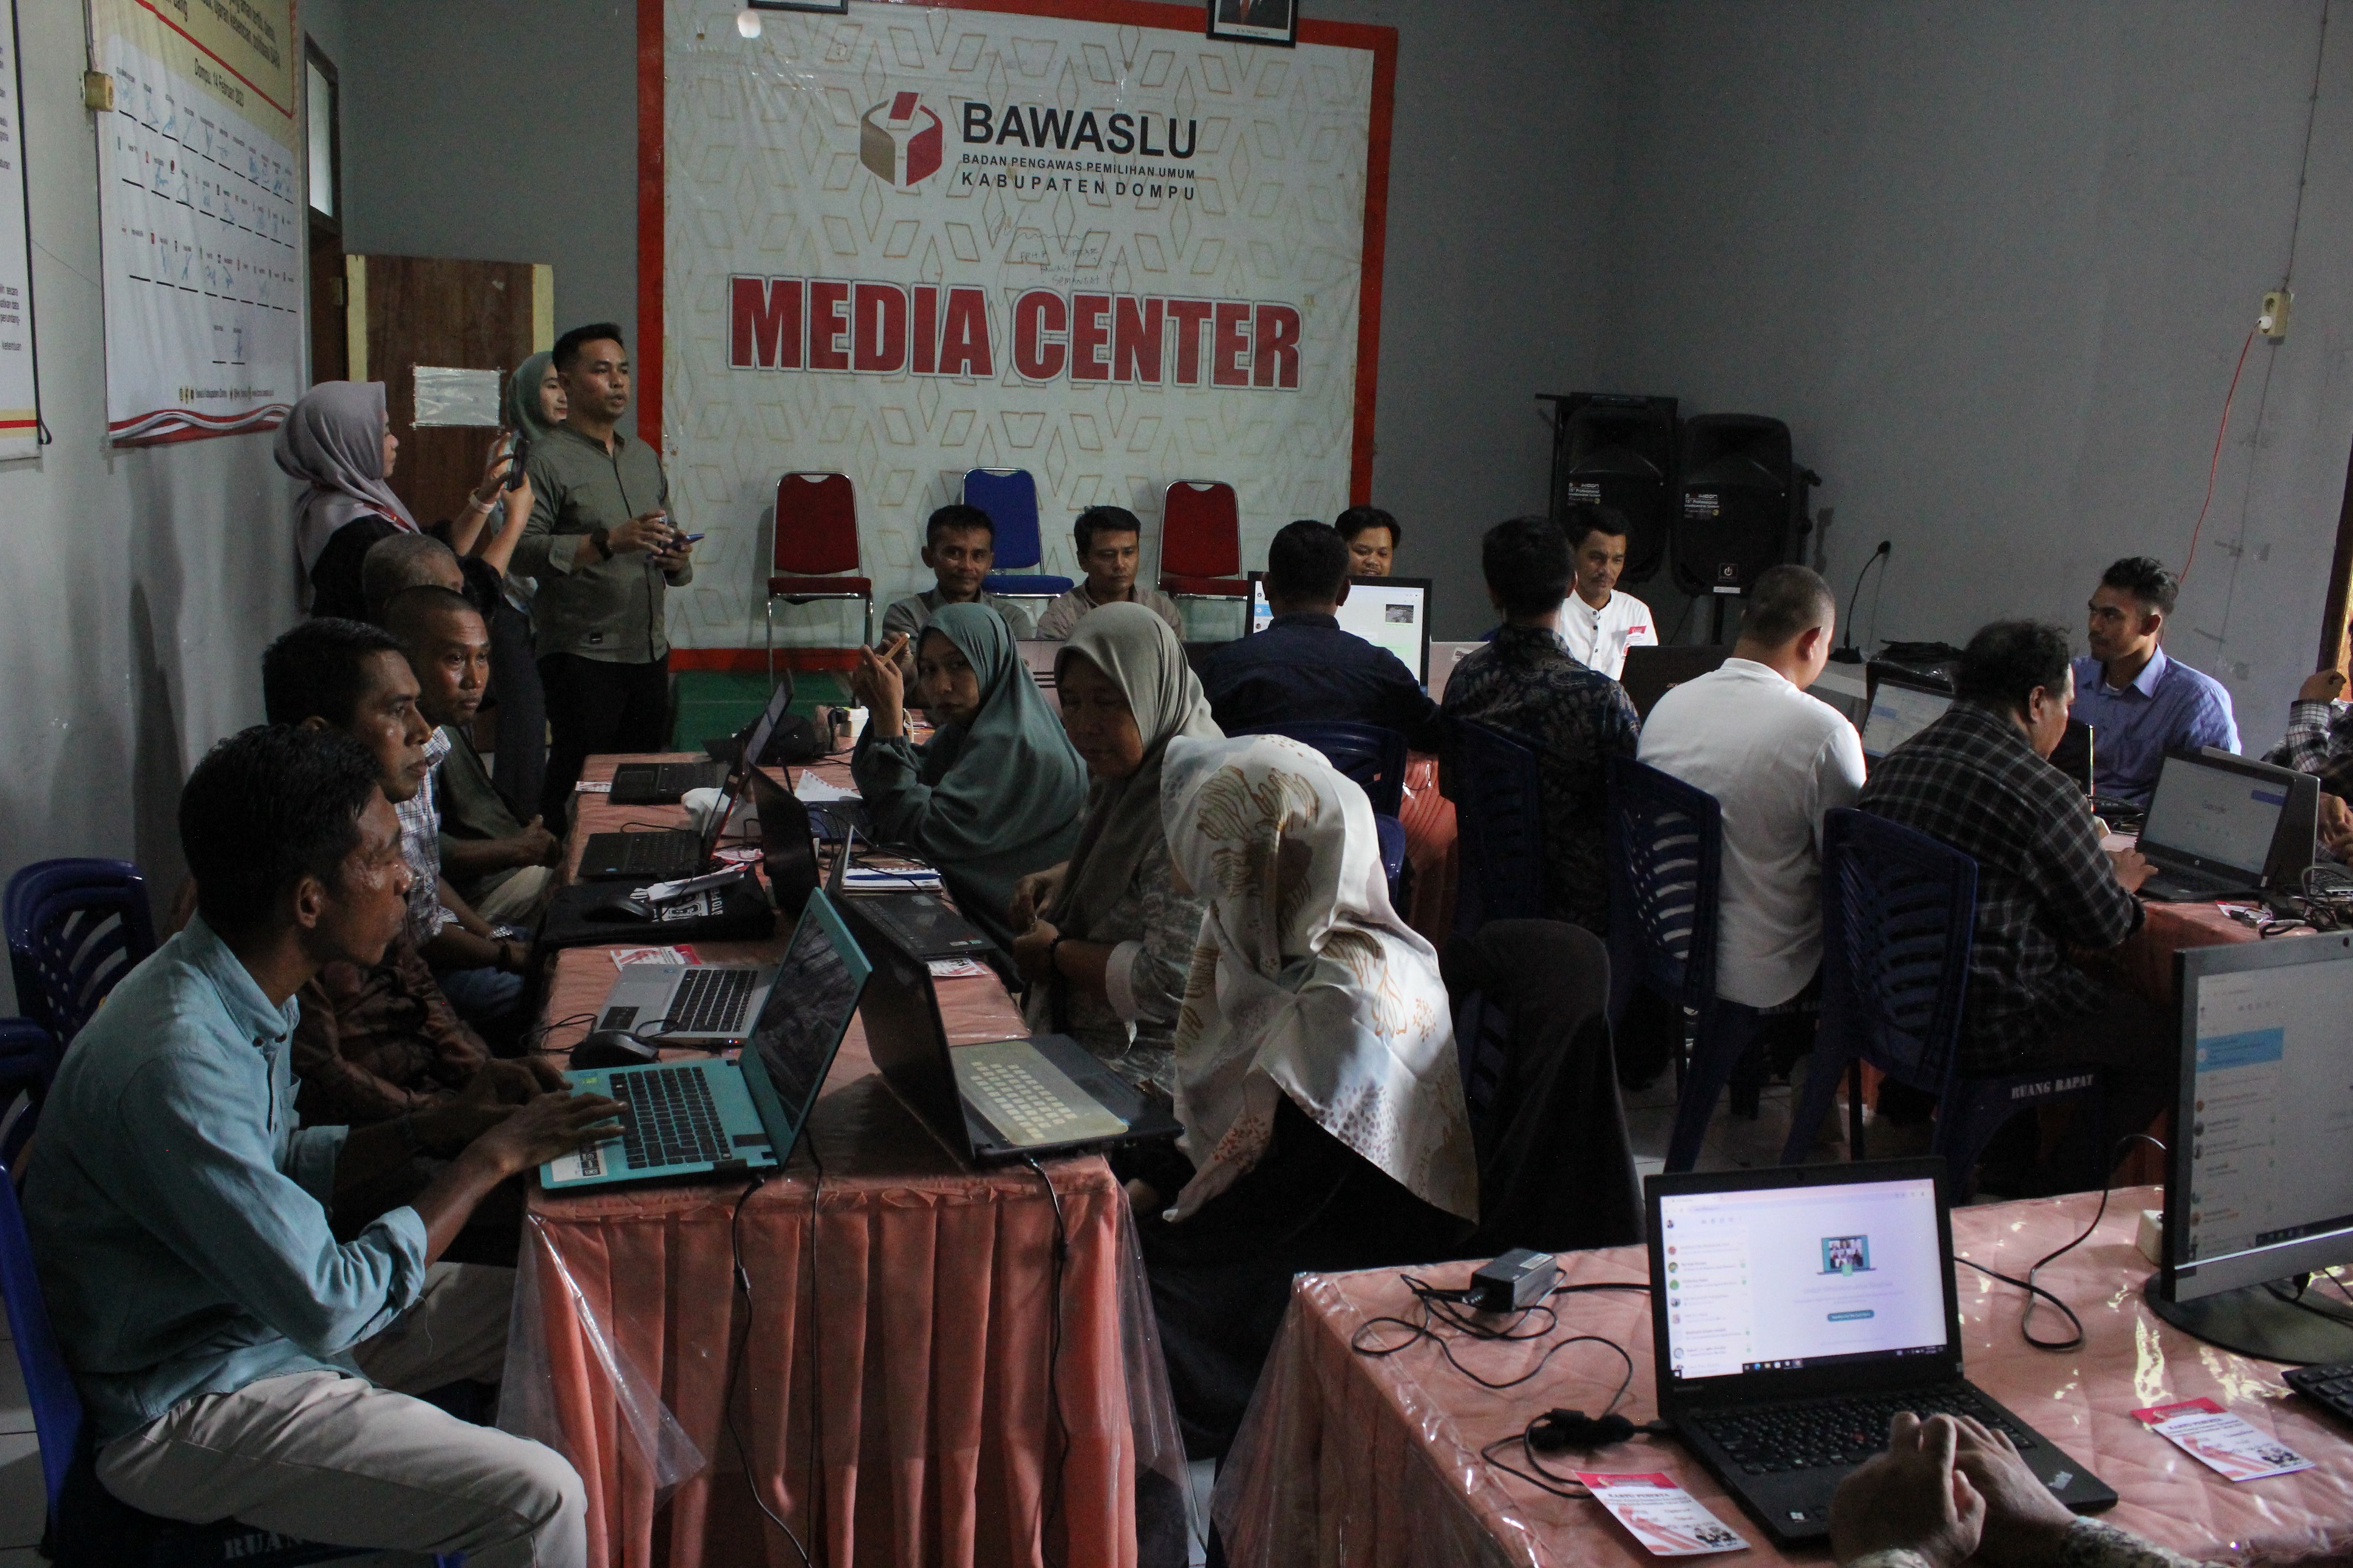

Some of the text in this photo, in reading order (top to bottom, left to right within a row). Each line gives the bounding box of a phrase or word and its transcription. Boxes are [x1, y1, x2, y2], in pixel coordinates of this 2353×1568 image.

[963, 102, 1196, 159] BAWASLU
[961, 171, 1194, 200] KABUPATEN DOMPU
[962, 154, 1007, 166] BADAN
[1011, 157, 1083, 171] PENGAWAS
[1159, 168, 1195, 179] UMUM
[729, 276, 1302, 389] MEDIA CENTER
